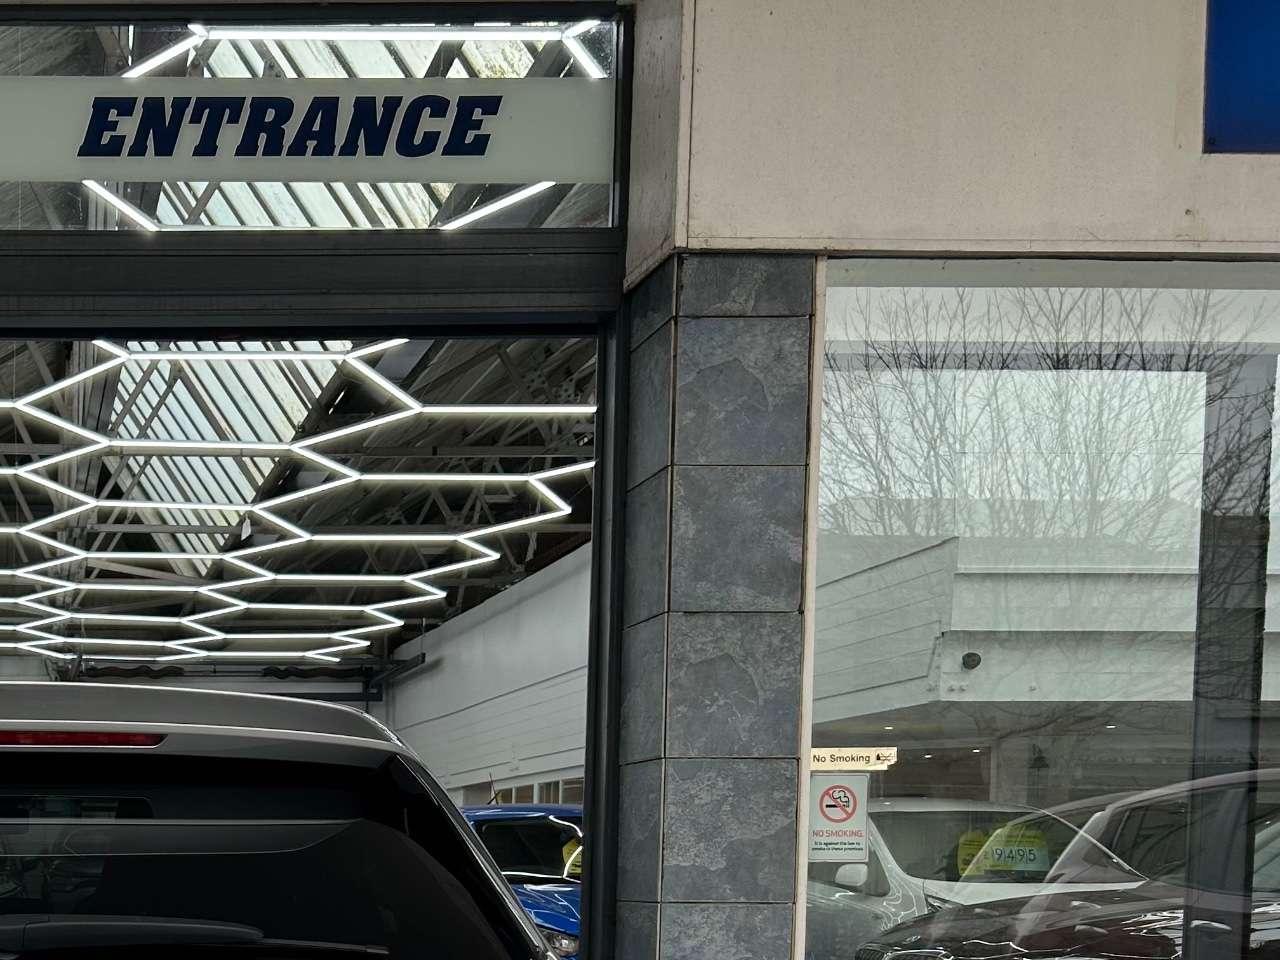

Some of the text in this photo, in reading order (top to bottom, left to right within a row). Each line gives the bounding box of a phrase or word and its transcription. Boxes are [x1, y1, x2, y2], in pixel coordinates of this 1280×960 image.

[77, 95, 504, 158] ENTRANCE
[813, 753, 871, 765] No Smoking
[812, 829, 824, 838] NO
